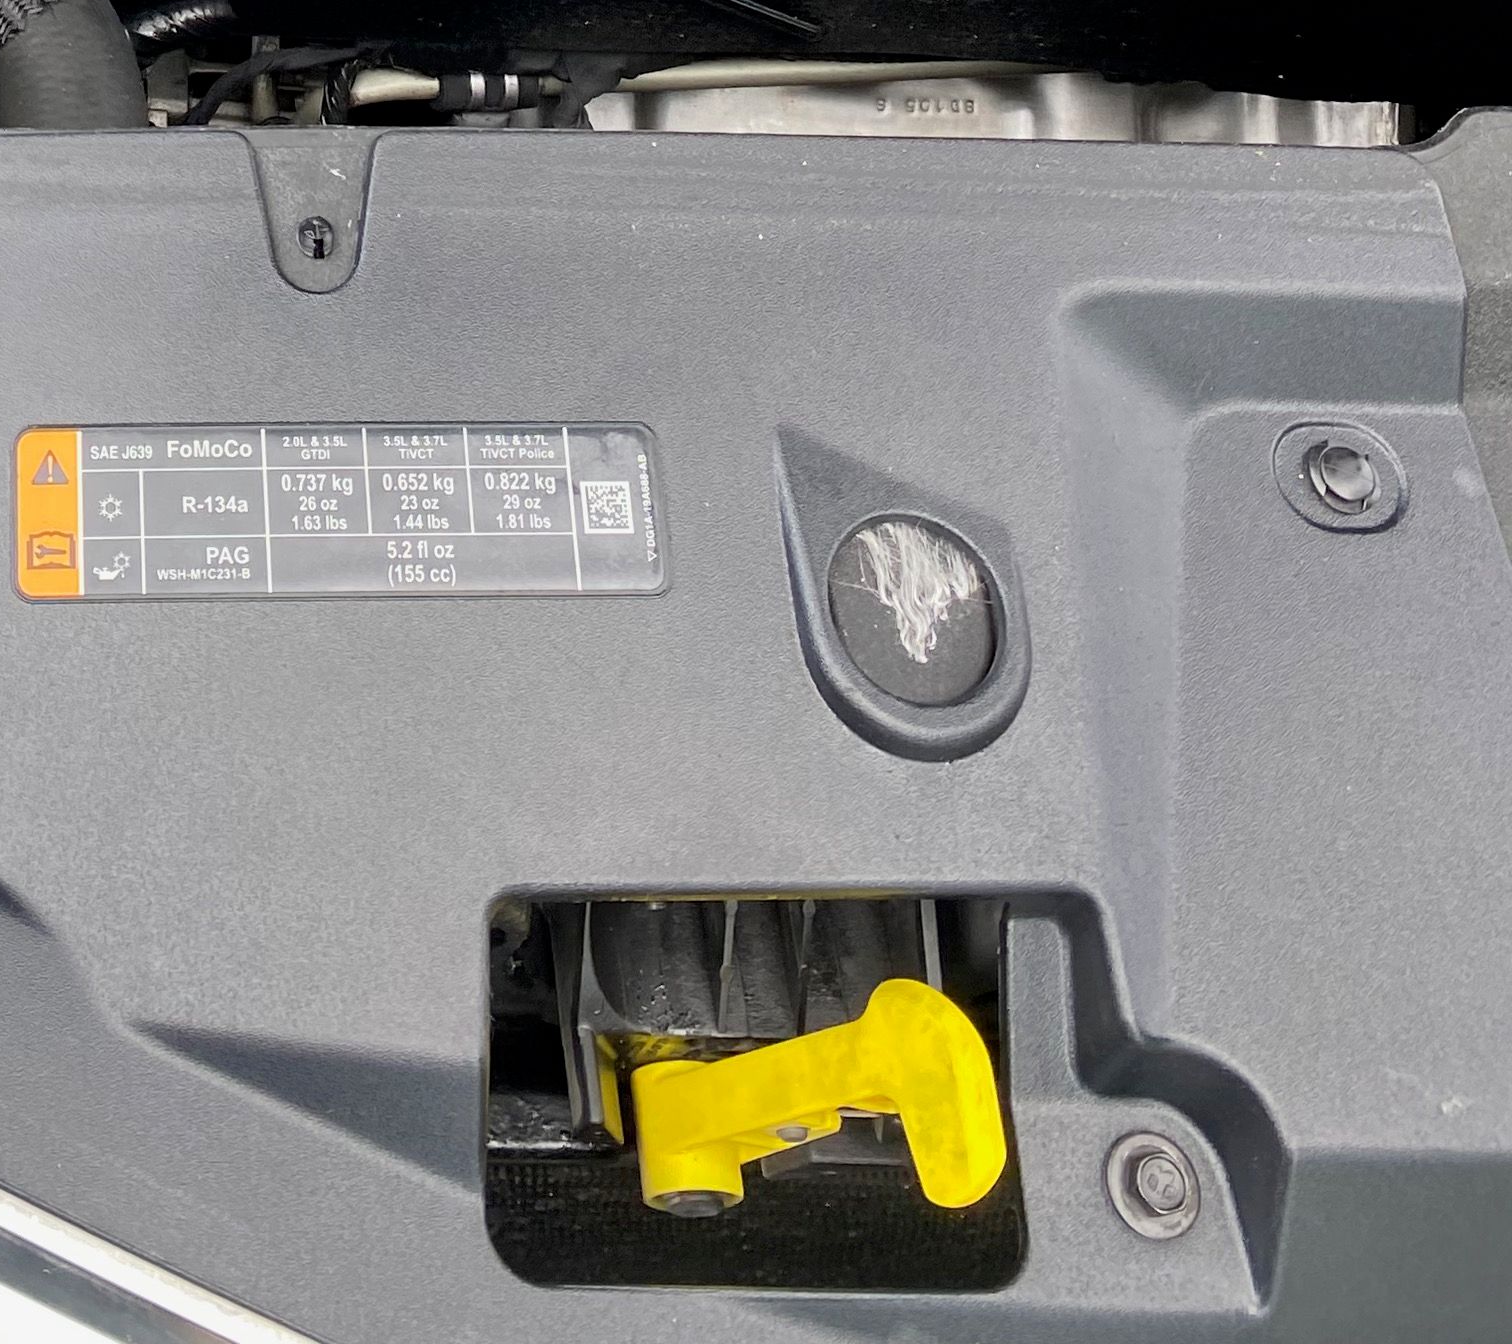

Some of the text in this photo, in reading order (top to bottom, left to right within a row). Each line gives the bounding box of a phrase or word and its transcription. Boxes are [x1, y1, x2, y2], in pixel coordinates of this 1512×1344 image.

[282, 436, 348, 448] 2.0L & 3.5L
[383, 436, 449, 447] 3.5L & 3.7L
[485, 435, 549, 446] 3.5L & 3.7L
[90, 445, 153, 460] SAE J639
[166, 439, 253, 458] FoMoCo
[519, 448, 555, 459] Police
[281, 474, 354, 495] 0.737 kg
[382, 473, 455, 495] 0.652 kg
[484, 472, 557, 494] 0.822 kg
[182, 496, 249, 513] R-134a
[299, 496, 338, 511] 26 oz
[400, 495, 440, 510] 23 oz
[503, 495, 541, 509] 29 oz
[291, 515, 348, 531] 1.63 lbs
[393, 514, 450, 530] 1.44 lbs
[495, 514, 552, 529] 1.81 lbs
[206, 547, 250, 564] PAG
[387, 541, 455, 559] 5.2 fl oz
[157, 568, 251, 580] WSH-M1C231-B
[388, 564, 456, 588] (155 cc)
